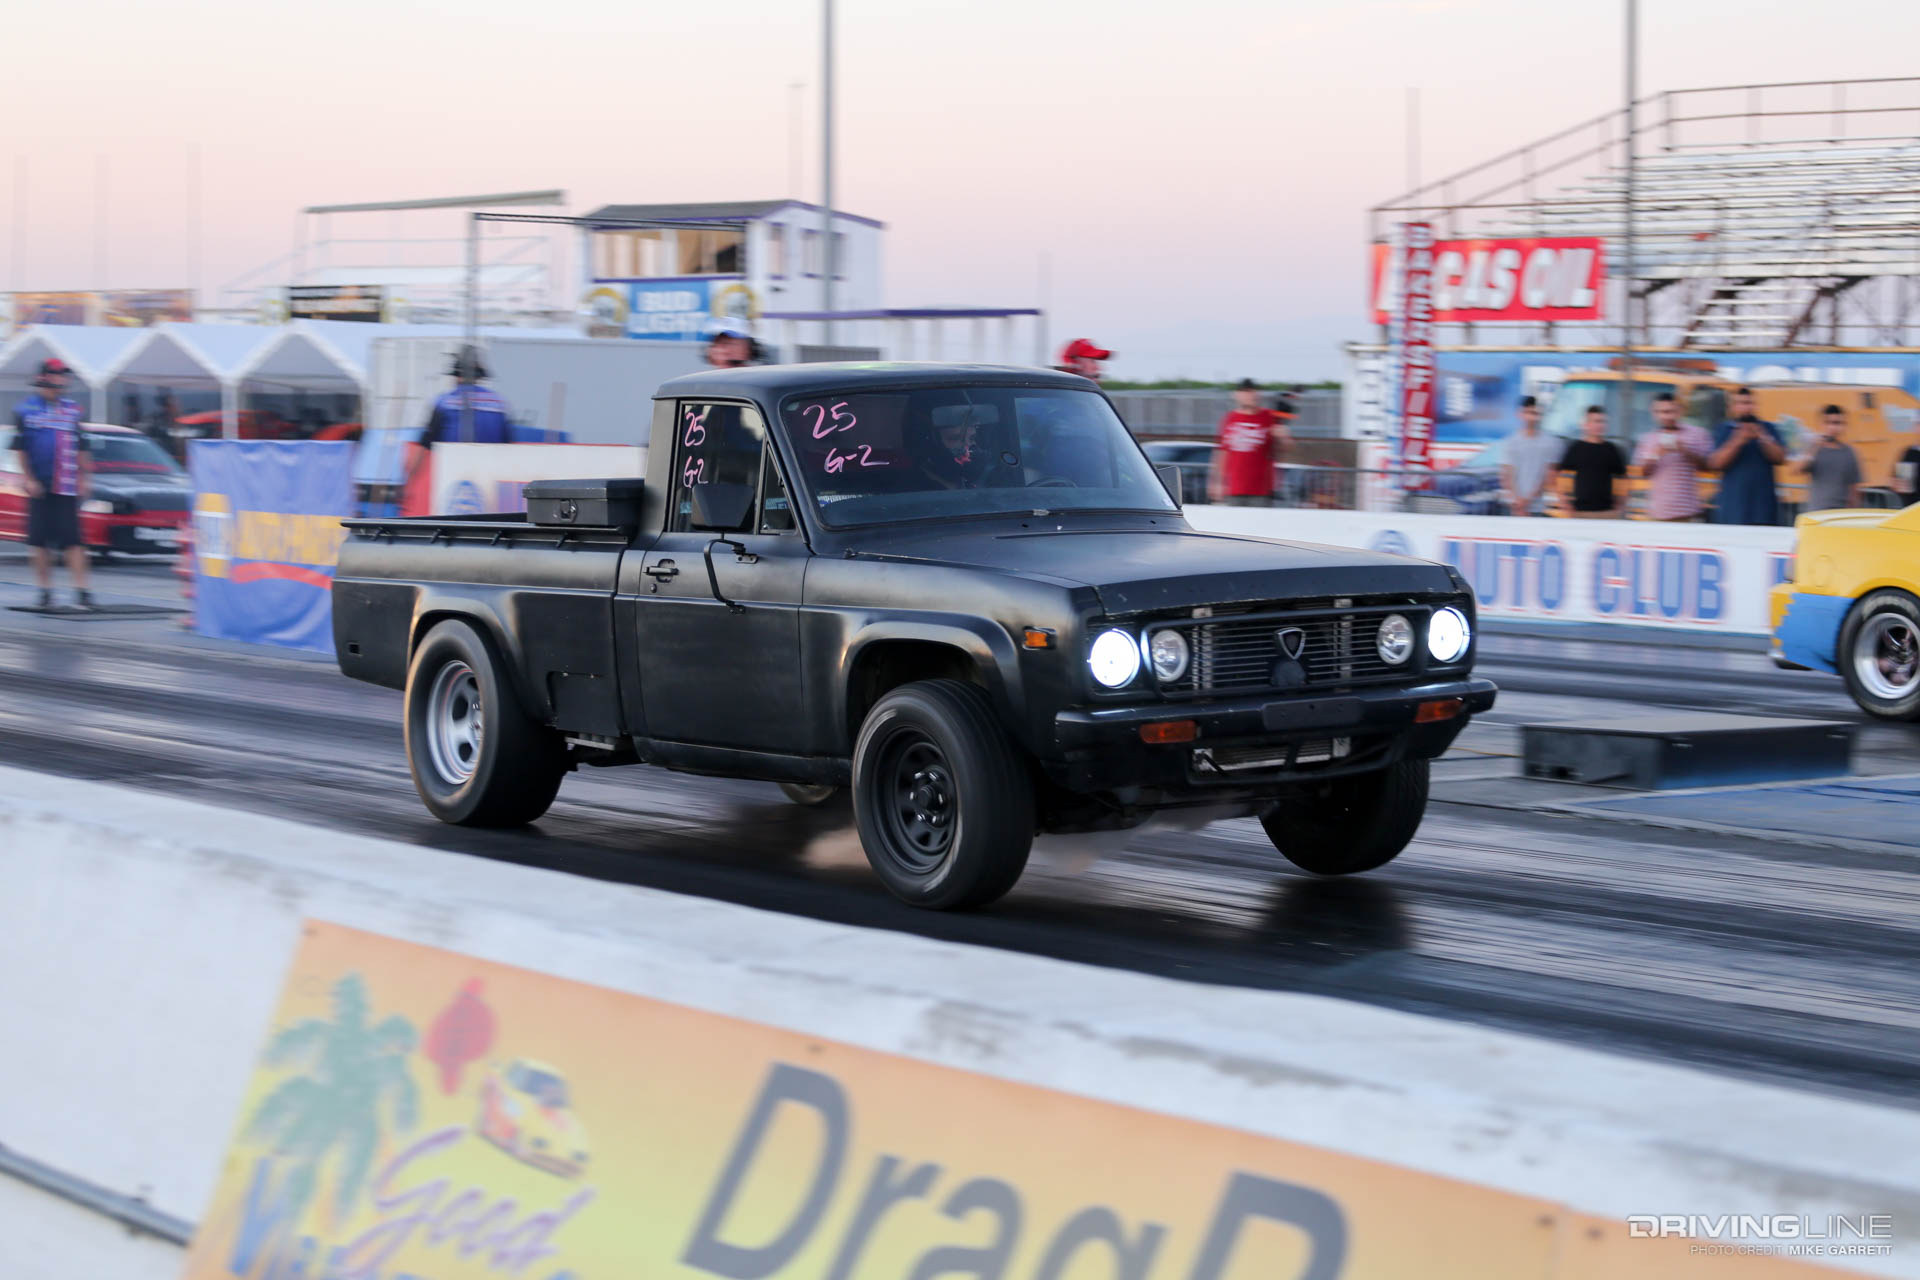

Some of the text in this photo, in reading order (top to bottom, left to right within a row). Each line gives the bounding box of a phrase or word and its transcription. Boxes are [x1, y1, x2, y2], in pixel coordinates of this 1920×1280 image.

[1378, 247, 1521, 311] LCAS
[684, 412, 706, 447] 25
[803, 401, 856, 439] 25
[1593, 541, 1728, 625] CLUB
